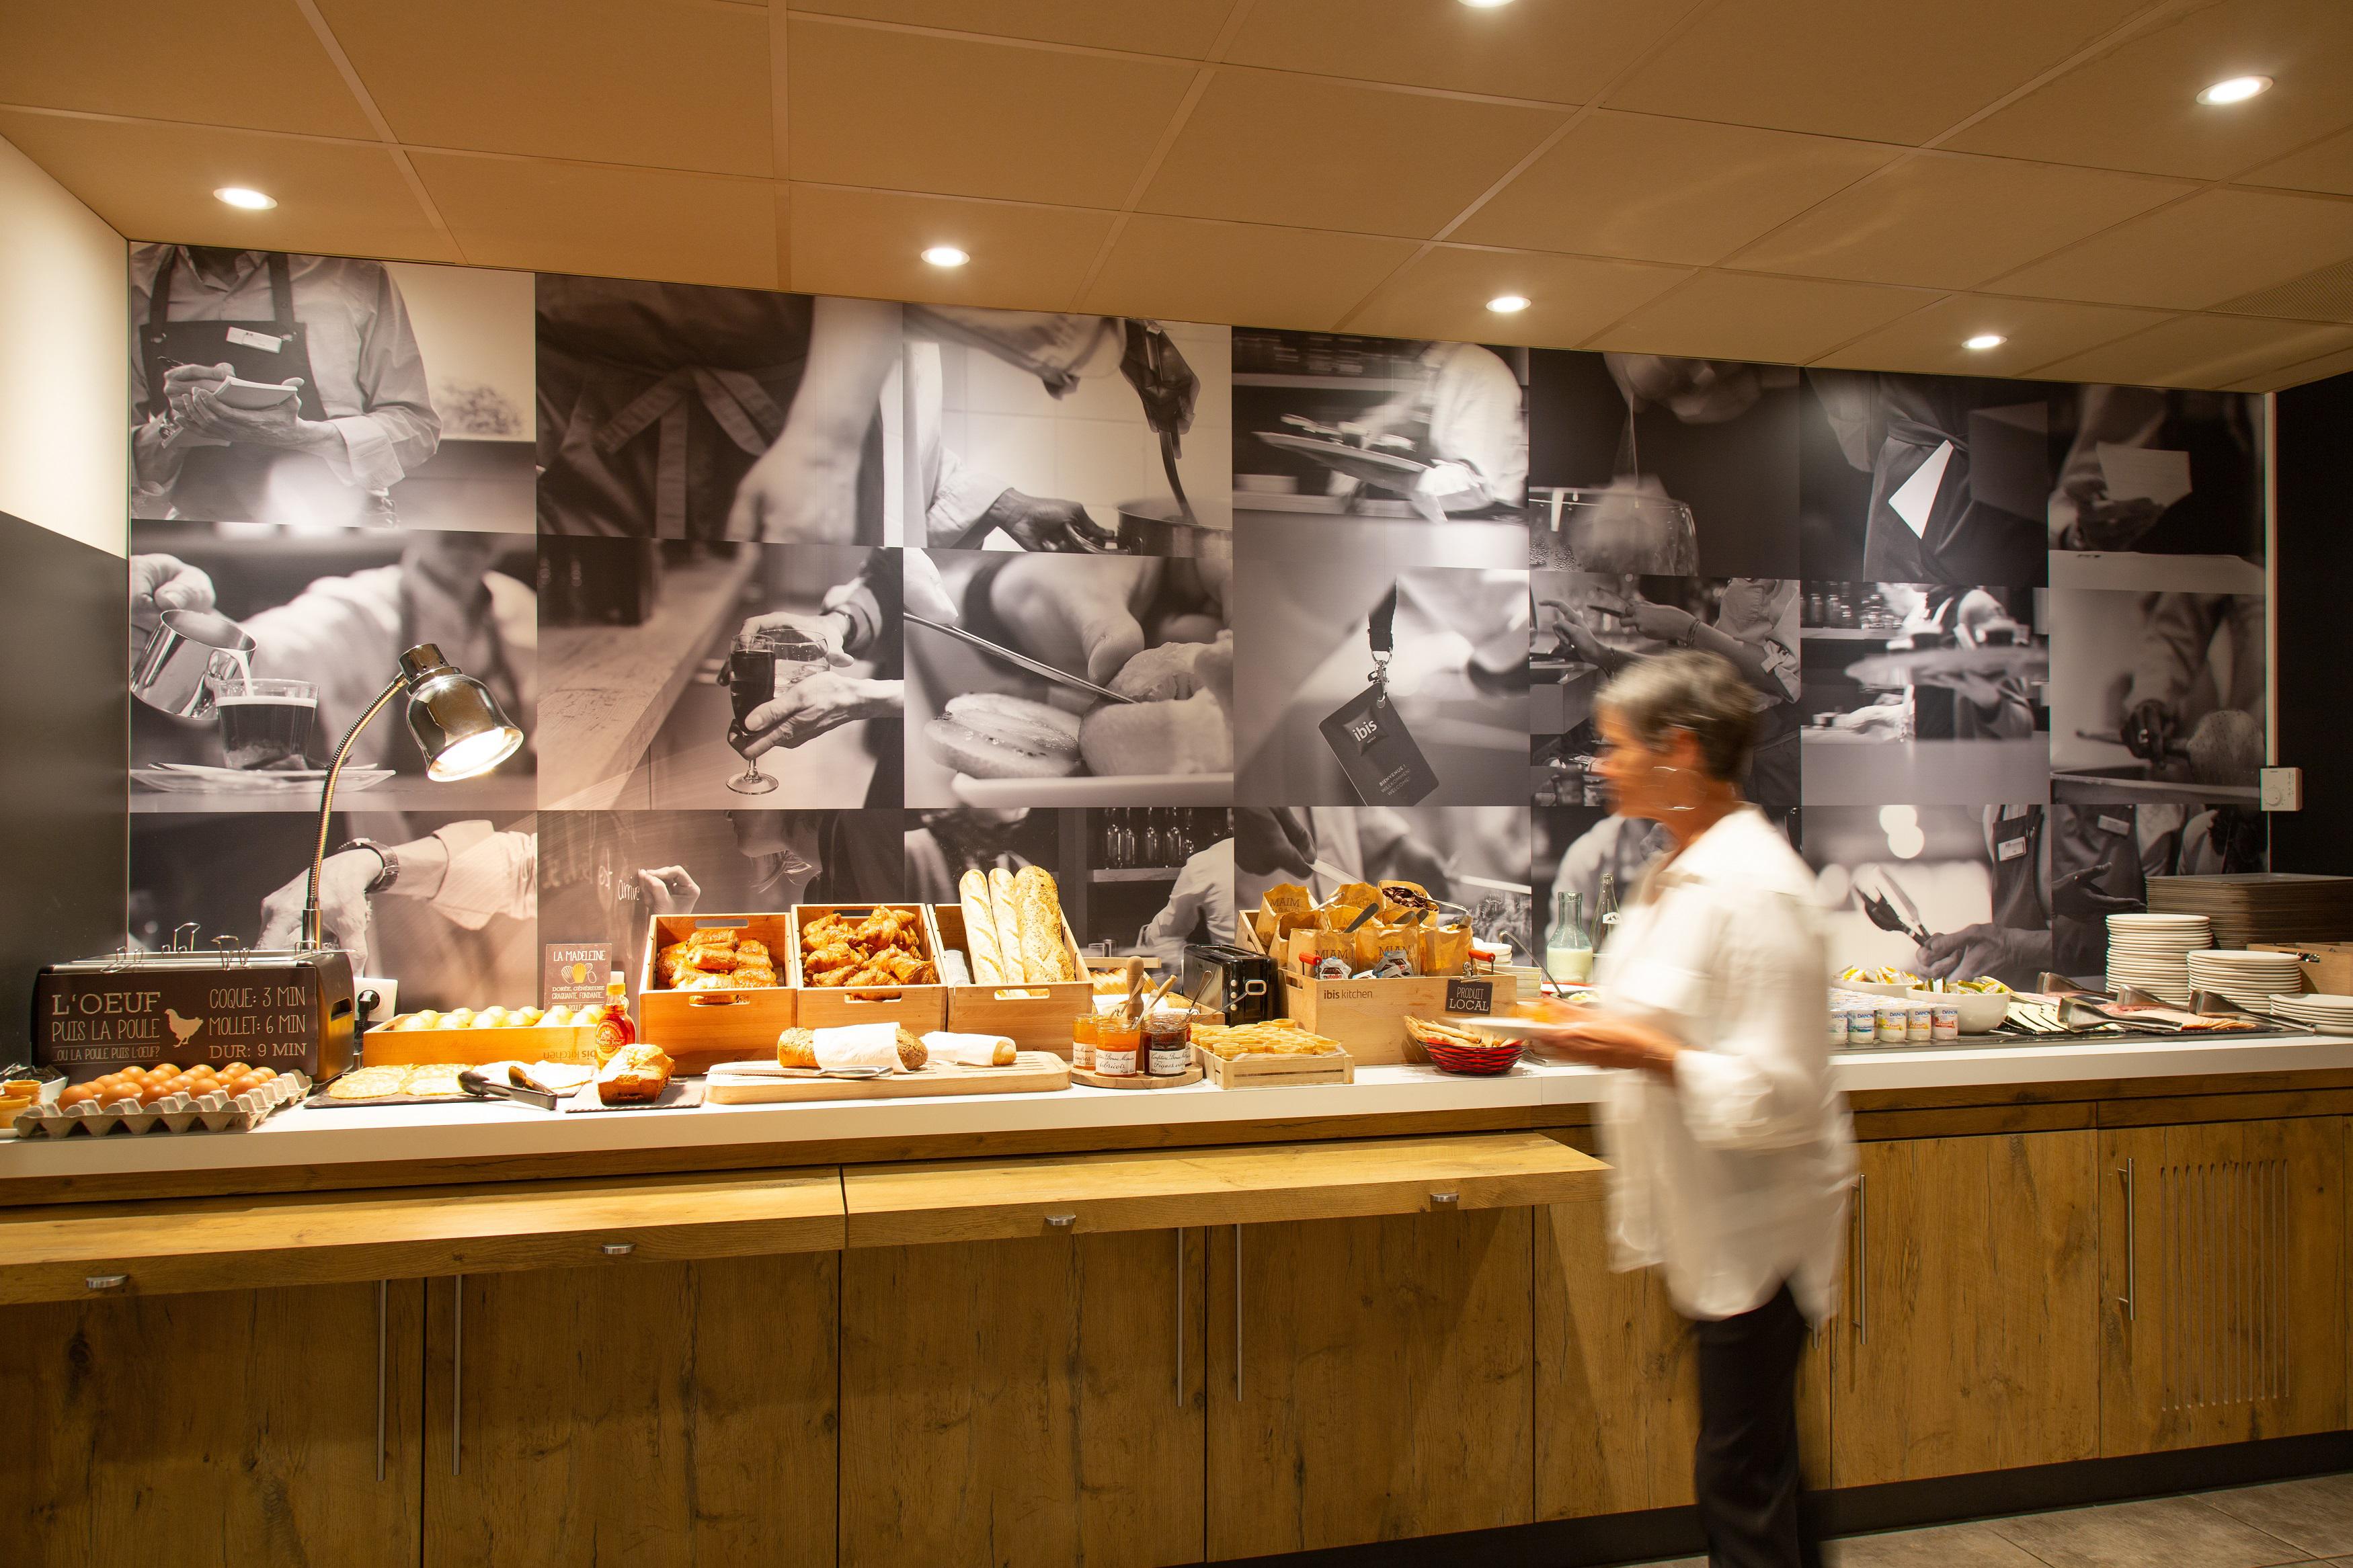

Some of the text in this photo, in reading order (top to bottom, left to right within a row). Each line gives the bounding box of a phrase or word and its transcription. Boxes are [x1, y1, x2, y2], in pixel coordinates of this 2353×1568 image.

[1352, 720, 1378, 742] ibis
[1379, 766, 1404, 786] BIENVENUE
[553, 950, 606, 961] LA MADELEINE
[1315, 949, 1348, 958] MIAM
[210, 987, 306, 1008] COQUE: 3 MIN
[1324, 989, 1373, 999] ibis kitchen
[1456, 987, 1484, 999] PRODUIT
[52, 991, 161, 1016] L'OEUF
[1449, 998, 1489, 1012] LOCAL
[52, 1018, 161, 1042] PUIS LA POULE
[209, 1015, 306, 1036] MOLLET: 6 MIN
[71, 1049, 85, 1060] LA
[85, 1048, 108, 1060] POULE
[111, 1047, 130, 1059] PUIS
[132, 1046, 160, 1058] L'OEUF?
[209, 1043, 307, 1059] DUR: 9 MIN
[582, 1050, 596, 1060] bis
